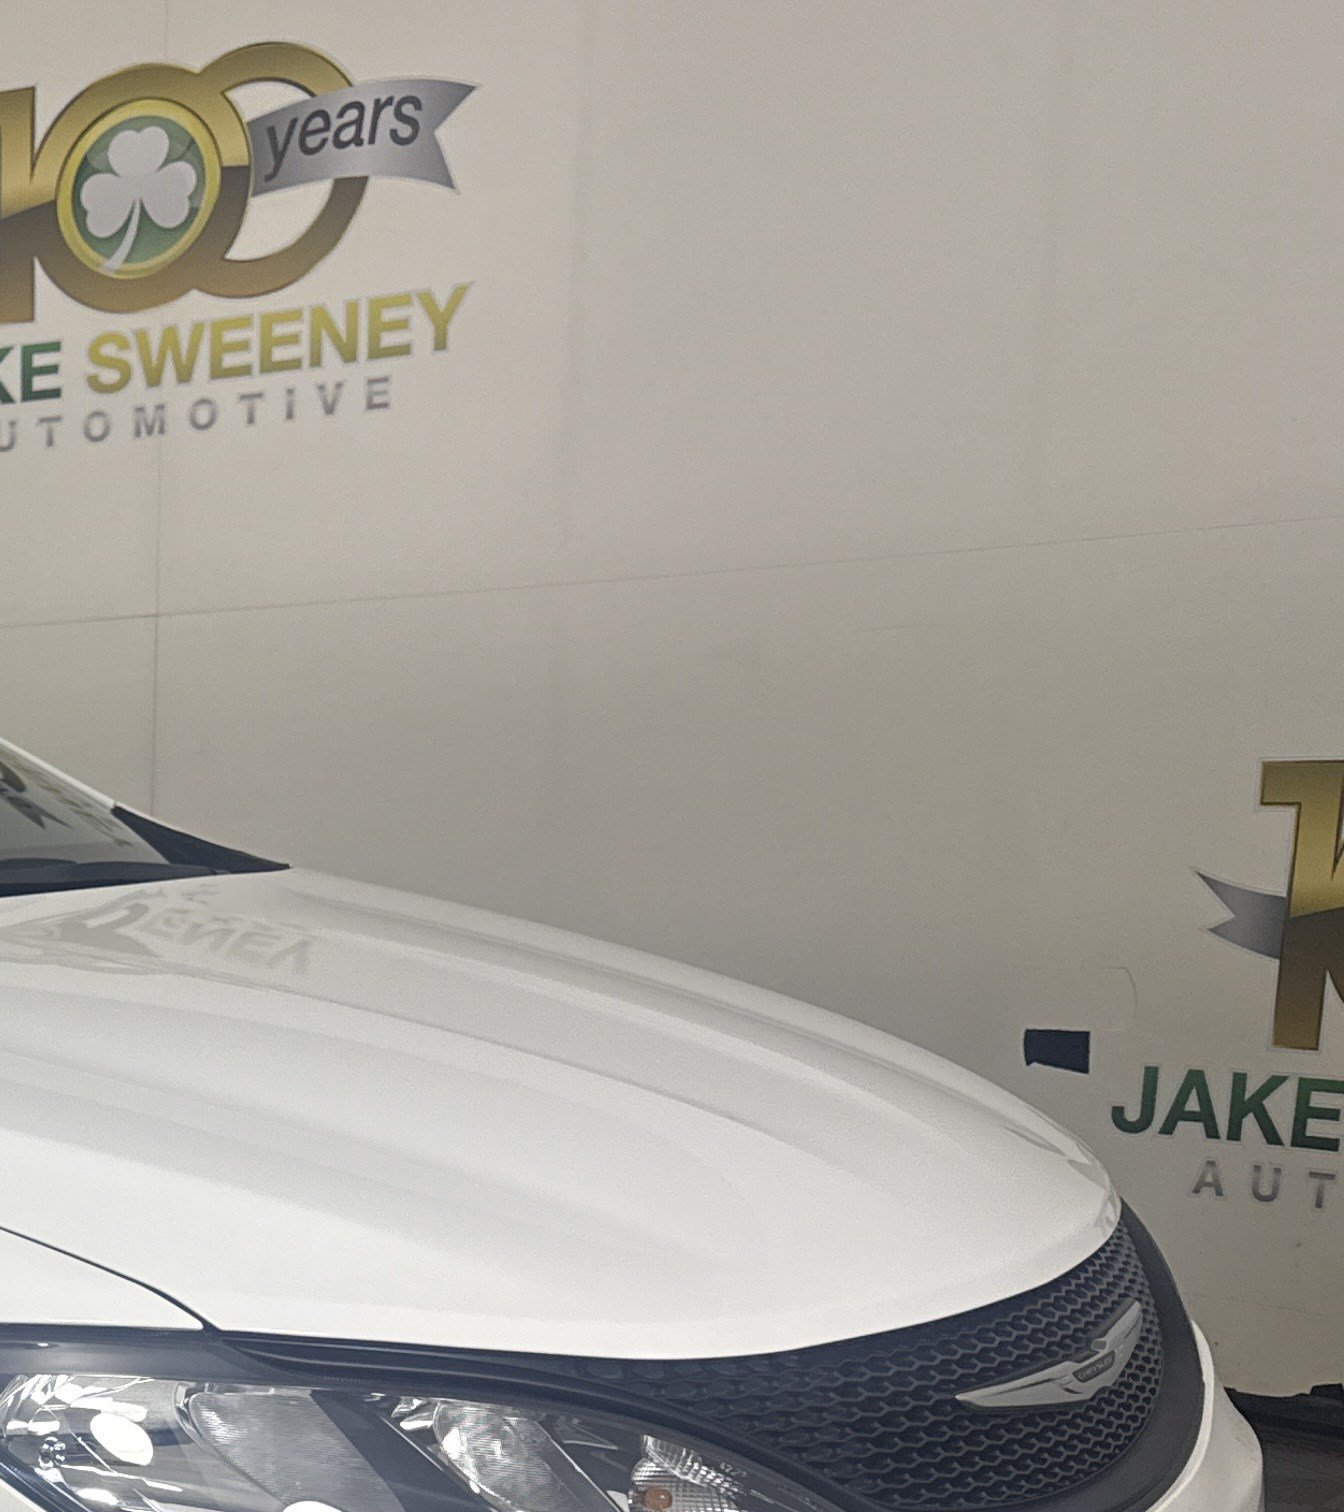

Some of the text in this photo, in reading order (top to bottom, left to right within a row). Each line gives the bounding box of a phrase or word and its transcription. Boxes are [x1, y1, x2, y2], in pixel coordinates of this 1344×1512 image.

[265, 94, 423, 182] years
[86, 281, 473, 394] SWEENEY
[1111, 1065, 1344, 1152] JAKE
